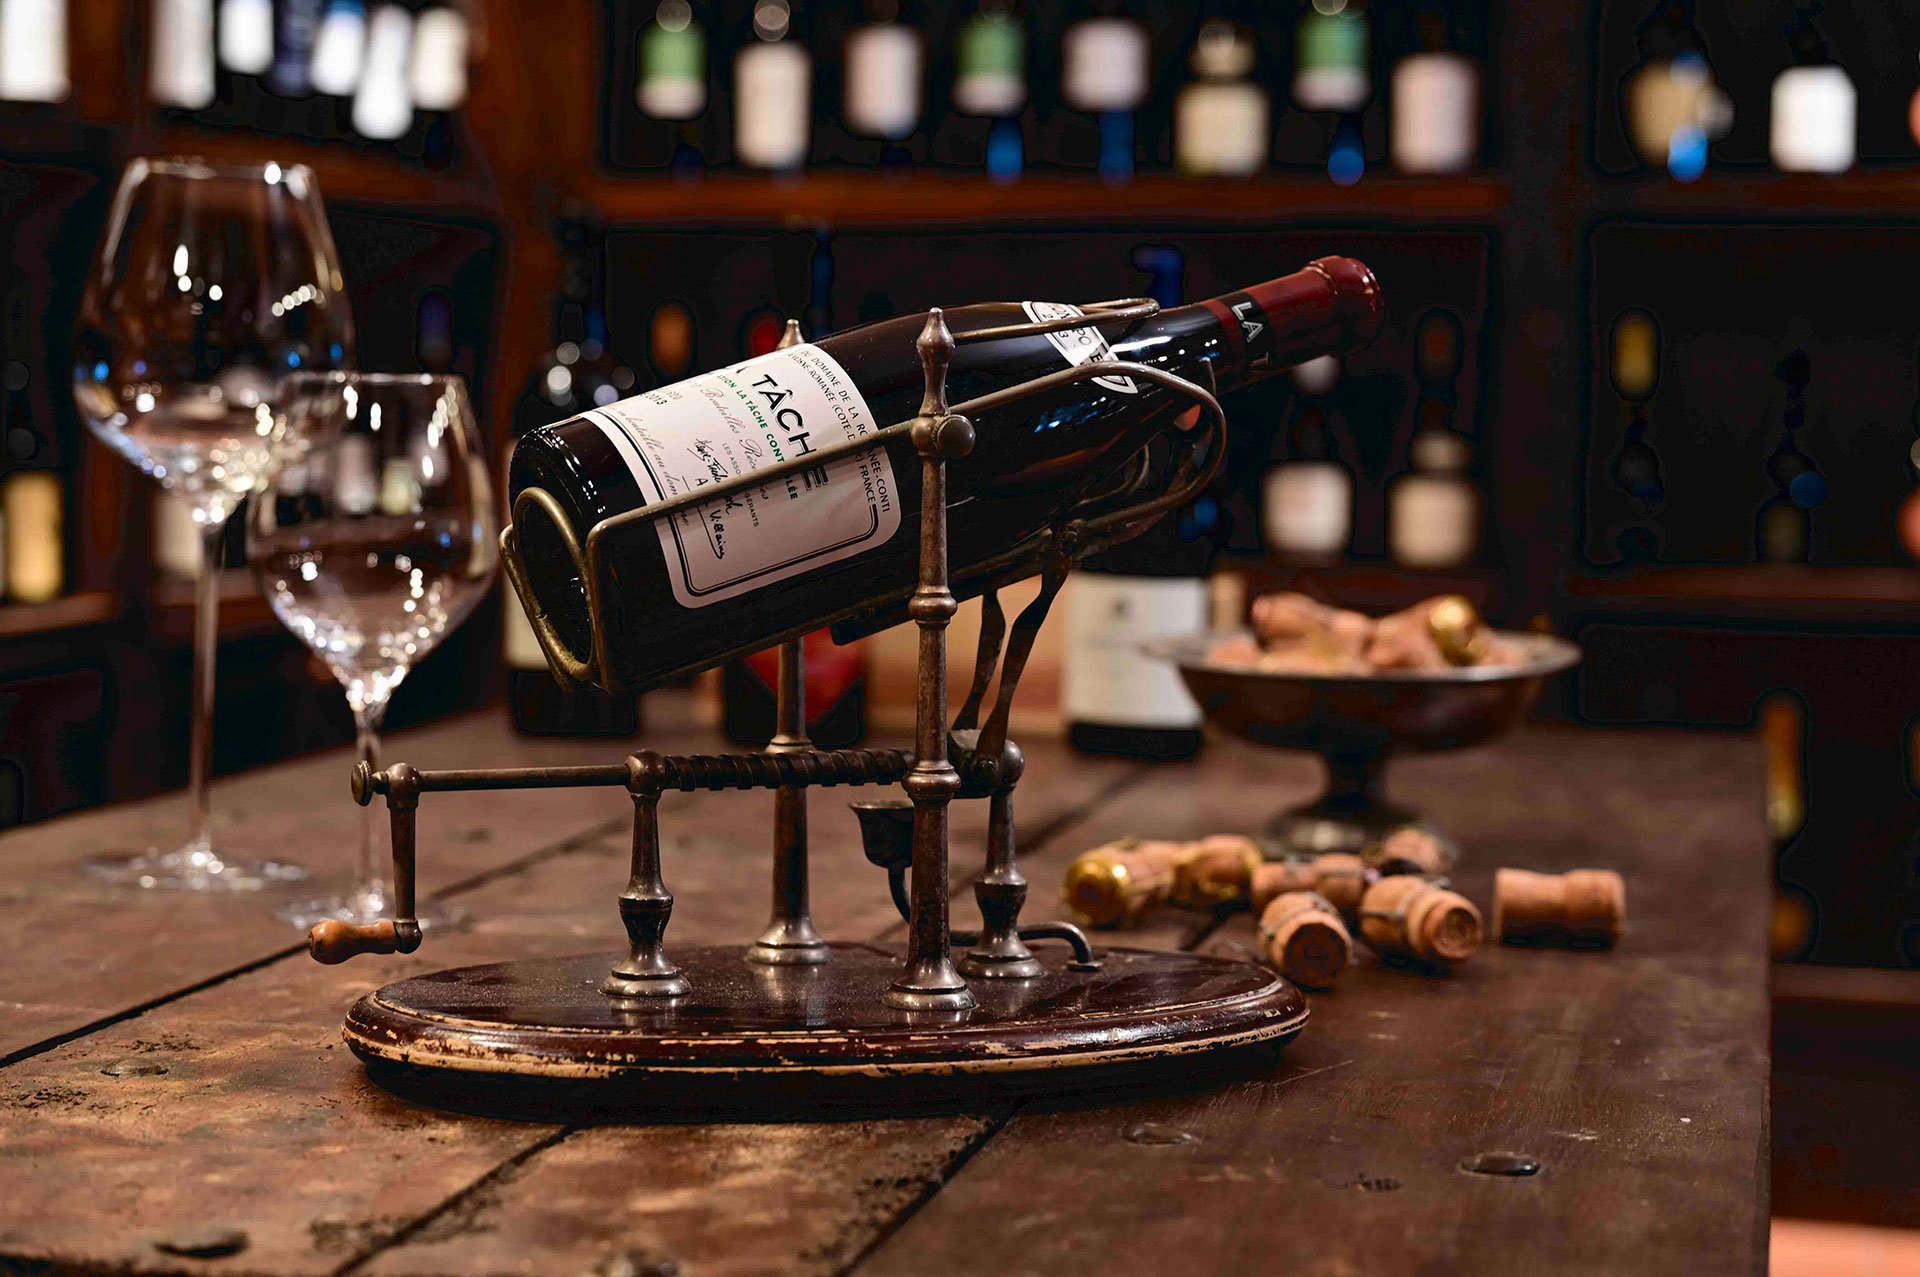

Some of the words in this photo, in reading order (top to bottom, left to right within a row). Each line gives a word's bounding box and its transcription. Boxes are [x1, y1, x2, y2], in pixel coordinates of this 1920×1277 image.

[1043, 313, 1068, 338] 23
[1231, 301, 1263, 343] LA
[700, 387, 746, 434] Bouteilles
[811, 357, 841, 387] DOMAINE
[838, 390, 851, 402] DE
[848, 406, 859, 419] LA
[625, 417, 664, 452] bouteille
[653, 453, 665, 469] au
[722, 442, 734, 457] LES
[736, 389, 748, 400] LA
[745, 400, 769, 429] TÂCHE
[766, 433, 799, 500] CONTLÉE
[752, 373, 829, 491] TÂCHE
[859, 465, 876, 503] FRANCE
